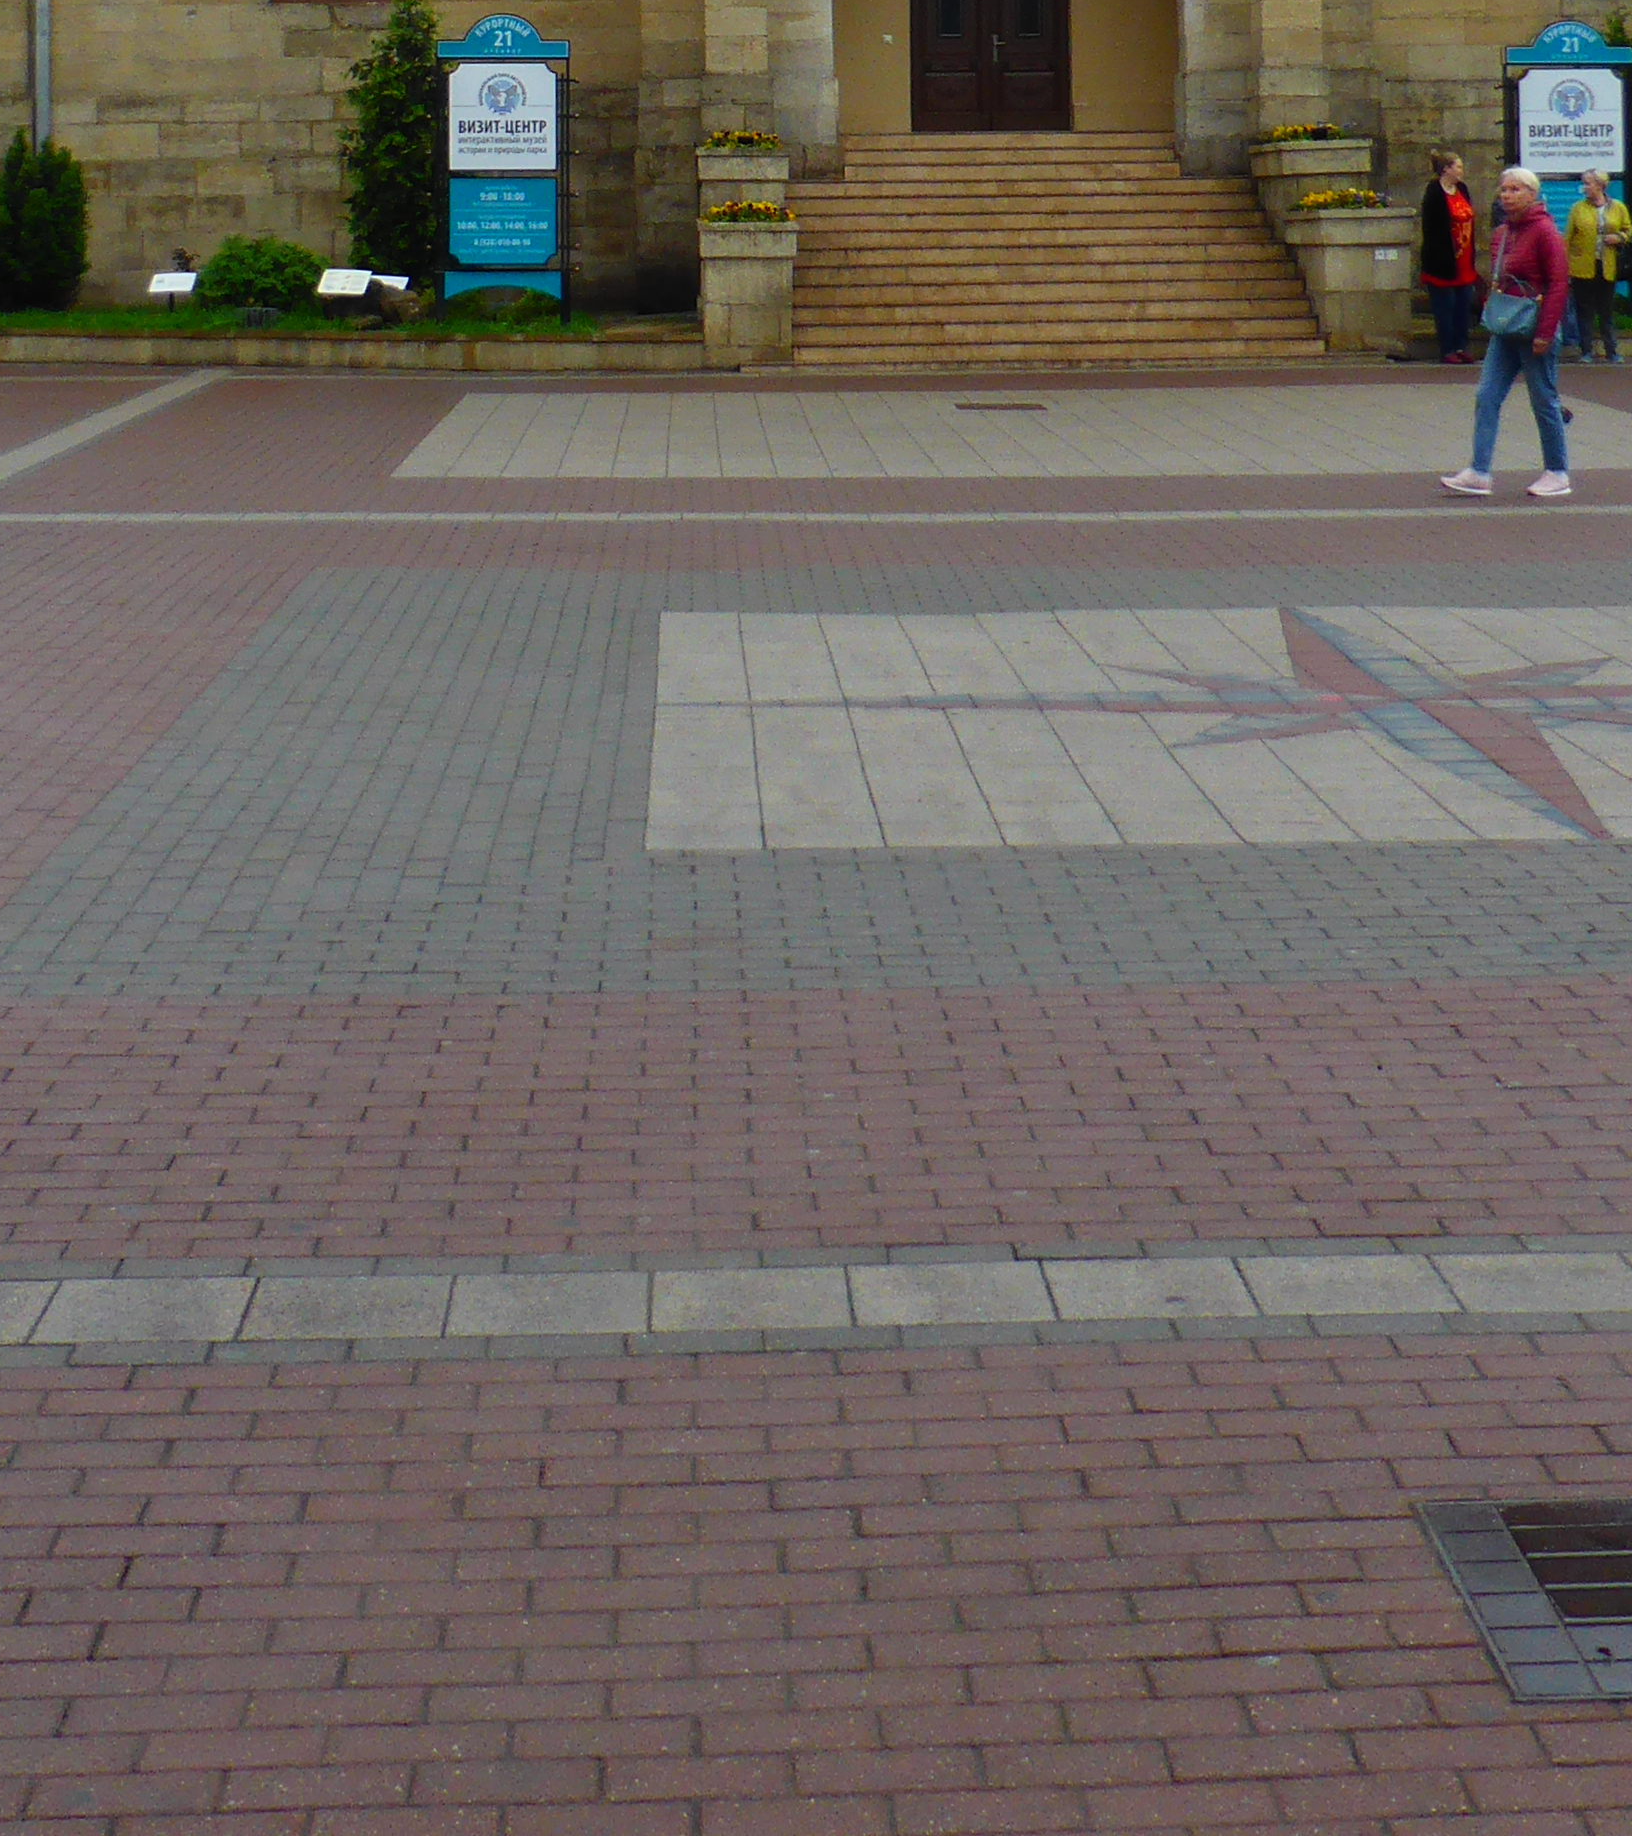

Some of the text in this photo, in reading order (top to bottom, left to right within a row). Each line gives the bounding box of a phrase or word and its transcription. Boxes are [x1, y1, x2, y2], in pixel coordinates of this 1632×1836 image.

[474, 18, 531, 37] КУРОРТНЫЙ
[493, 30, 512, 47] 21
[1561, 36, 1580, 53] 21
[458, 119, 547, 136] ВИЗИТ-ЦЕНТР
[1528, 124, 1614, 139] ВИЗИТ-ЦЕНТР
